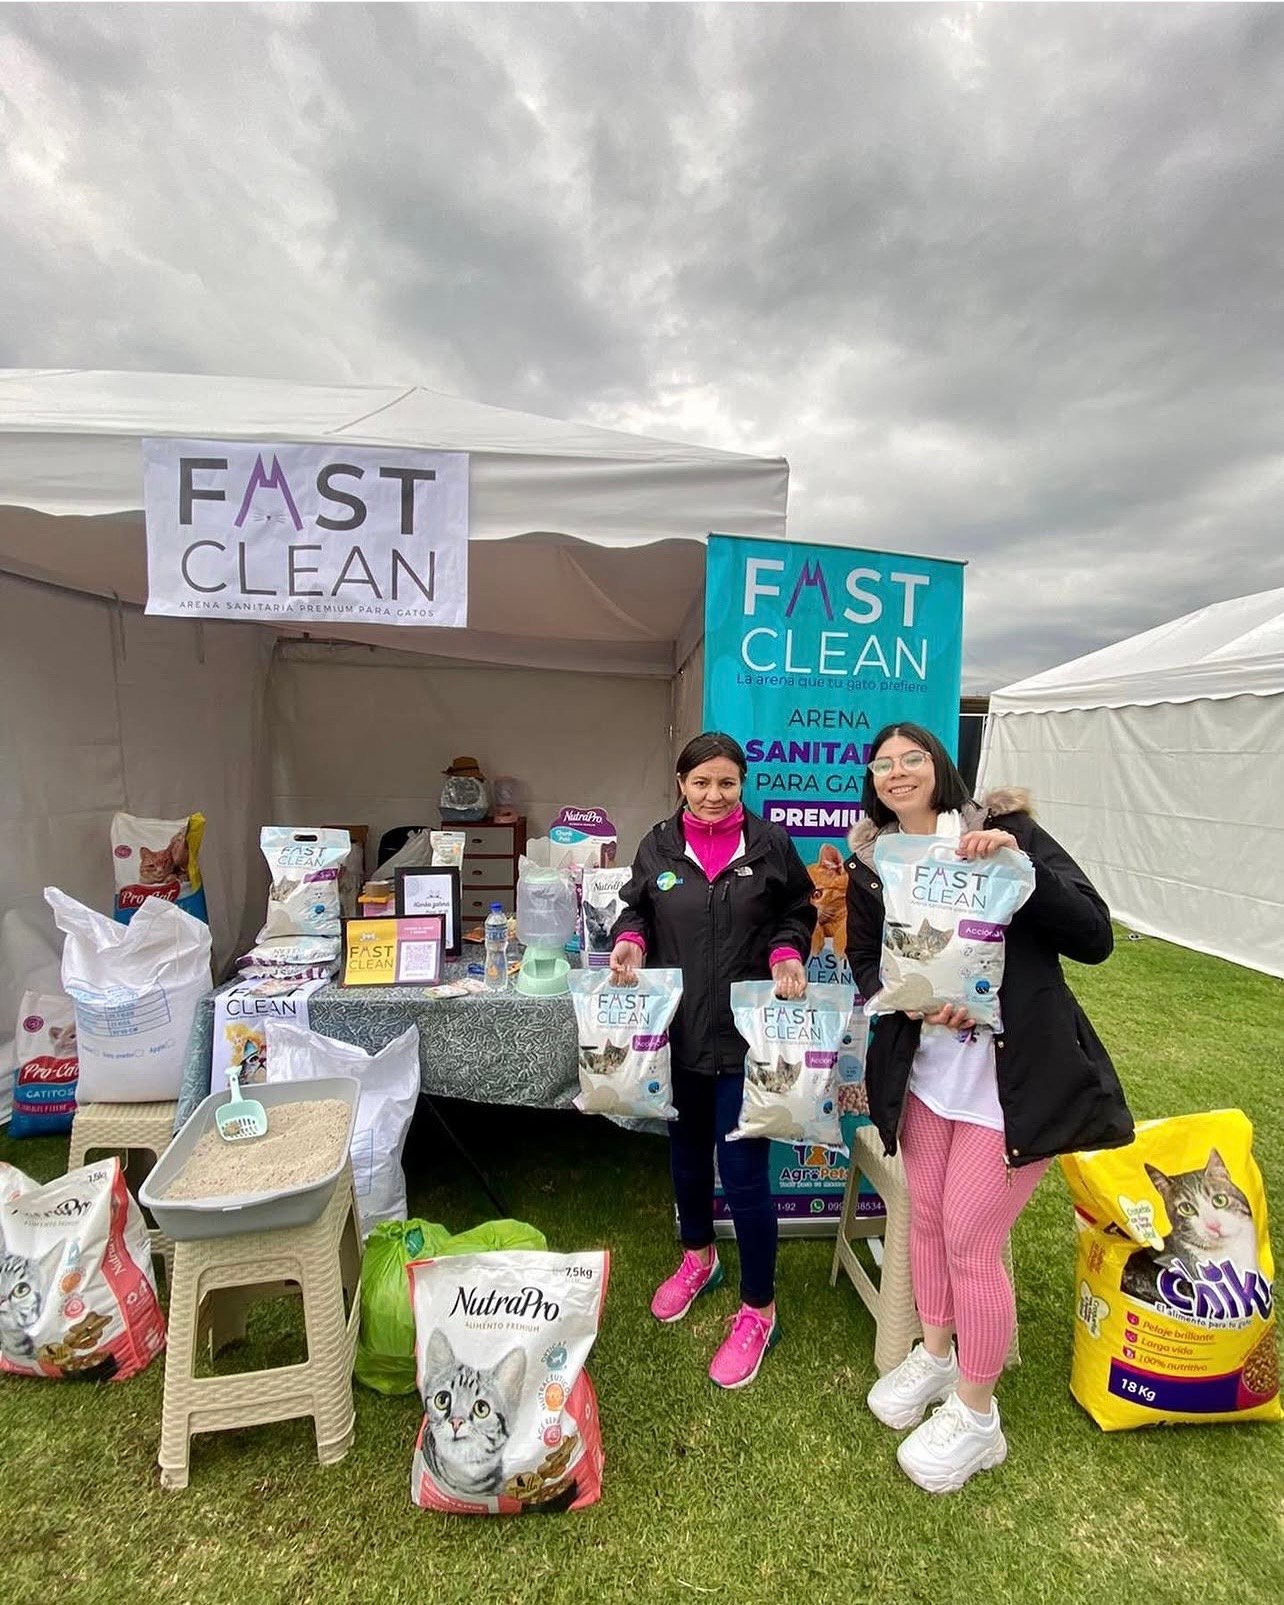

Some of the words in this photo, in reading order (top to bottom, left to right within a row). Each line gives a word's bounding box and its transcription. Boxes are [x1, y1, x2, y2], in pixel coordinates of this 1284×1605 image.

[179, 452, 436, 535] FAST
[181, 540, 436, 601] CLEAN
[744, 557, 930, 628] FAST
[179, 601, 220, 610] ARENA
[226, 602, 294, 613] SANITARIA
[300, 604, 354, 614] PREMIUM
[358, 606, 391, 616] PARA
[396, 609, 435, 618] GATOS
[740, 627, 927, 680] CLEAN
[736, 674, 752, 685] La
[755, 676, 794, 687] arena
[798, 678, 825, 690] que
[827, 678, 843, 689] tu
[847, 679, 876, 692] gato
[879, 681, 928, 694] prefiere
[788, 709, 870, 729] ARENA
[756, 773, 819, 792] PARA
[562, 810, 602, 824] NutraPro
[770, 808, 866, 828] PREMIU
[278, 855, 325, 867] CLEAN
[593, 880, 624, 892] NutraP
[914, 866, 988, 892] FAST
[912, 886, 987, 910] CLEAN
[350, 945, 393, 958] FAST
[349, 959, 393, 970] CLEAN
[807, 970, 852, 985] LEAN
[226, 999, 297, 1016] CLEAN
[598, 993, 650, 1010] FAST
[597, 1011, 650, 1026] CLEAN
[764, 1006, 817, 1025] FAST
[765, 1026, 822, 1041] CLEAN
[26, 1087, 74, 1099] CATITOS
[565, 1266, 593, 1280] 7,5kg
[448, 1286, 560, 1322] NutraPro
[1156, 1303, 1166, 1313] El
[1168, 1308, 1206, 1326] alimento
[1208, 1321, 1227, 1329] para
[465, 1321, 504, 1330] ALIMENTO
[506, 1322, 540, 1333] PREMIUM
[1143, 1321, 1173, 1338] Pelaje
[1174, 1328, 1216, 1342] brillante
[1141, 1337, 1171, 1353] Larga
[1172, 1346, 1194, 1356] vida
[1138, 1354, 1166, 1369] 100%
[1167, 1360, 1208, 1372] nutritivo
[1122, 1378, 1138, 1393] 18
[1138, 1385, 1156, 1402] Kg
